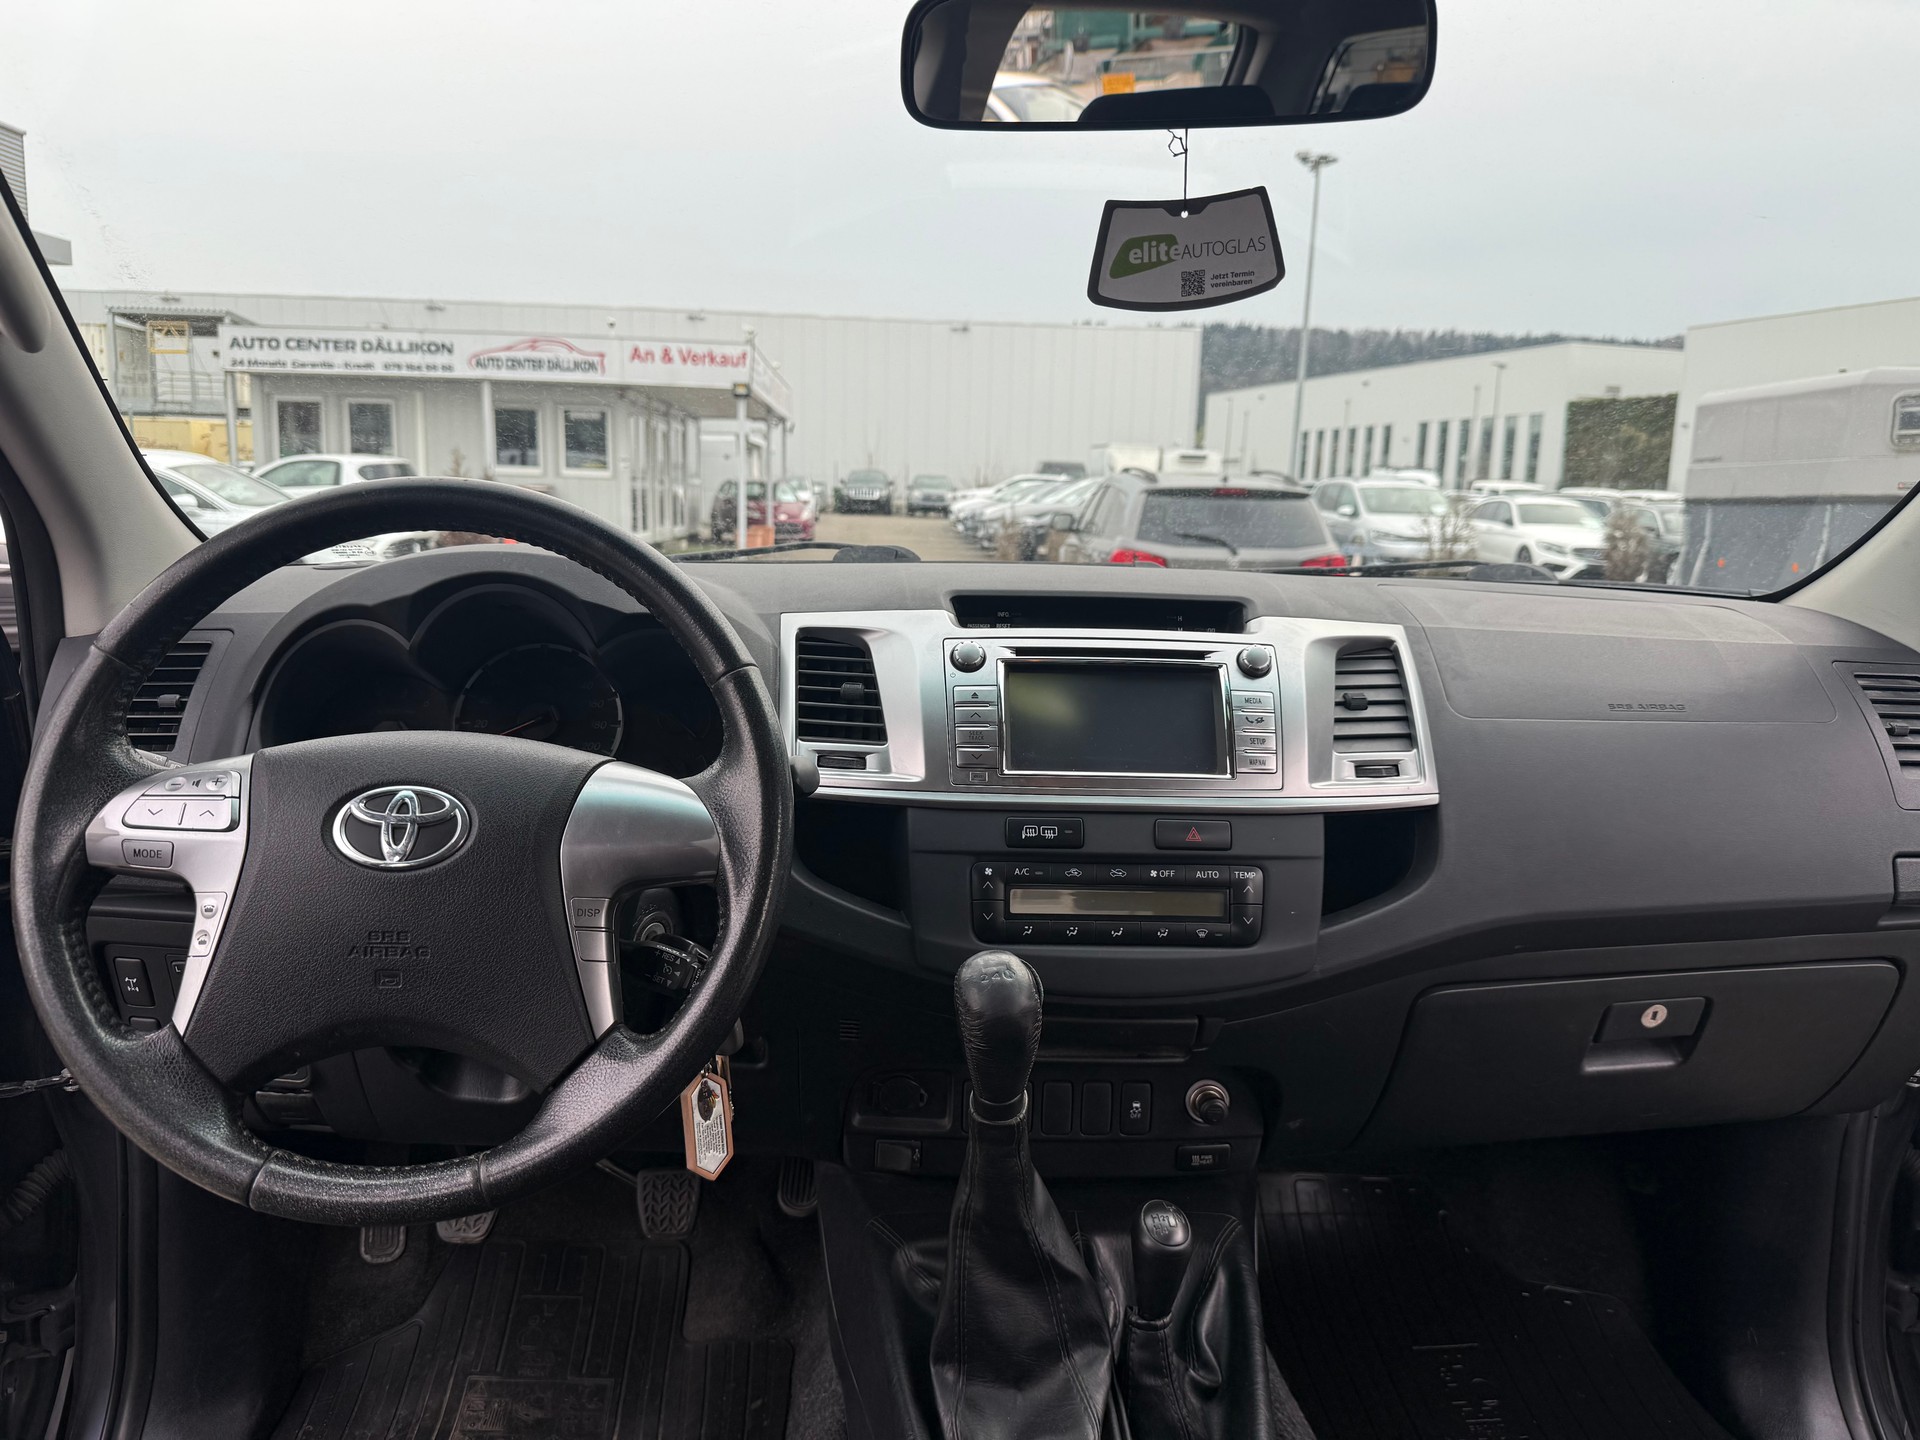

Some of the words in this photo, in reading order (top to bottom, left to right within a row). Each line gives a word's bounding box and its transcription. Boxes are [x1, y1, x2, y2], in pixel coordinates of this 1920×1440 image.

[1210, 272, 1229, 281] Jetzt
[1230, 270, 1256, 279] Termin
[1210, 278, 1254, 289] vereinbaren
[229, 336, 281, 351] AUTO
[285, 337, 357, 353] CENTER
[361, 336, 455, 355] DÄLLIKON
[629, 345, 656, 365] An
[661, 346, 674, 365] &
[679, 347, 748, 368] Verkauf
[474, 356, 504, 370] AUTO
[1244, 696, 1263, 705] MEDIA
[1637, 703, 1687, 711] AIRBAG
[1249, 737, 1267, 746] SETUP
[132, 847, 163, 860] MODE
[1014, 866, 1030, 876] A/C
[1159, 868, 1176, 878] OFF
[1195, 870, 1220, 879] AUTO
[1234, 871, 1257, 880] TEMP
[576, 908, 601, 917] DISP
[346, 946, 431, 959] AIRBAG
